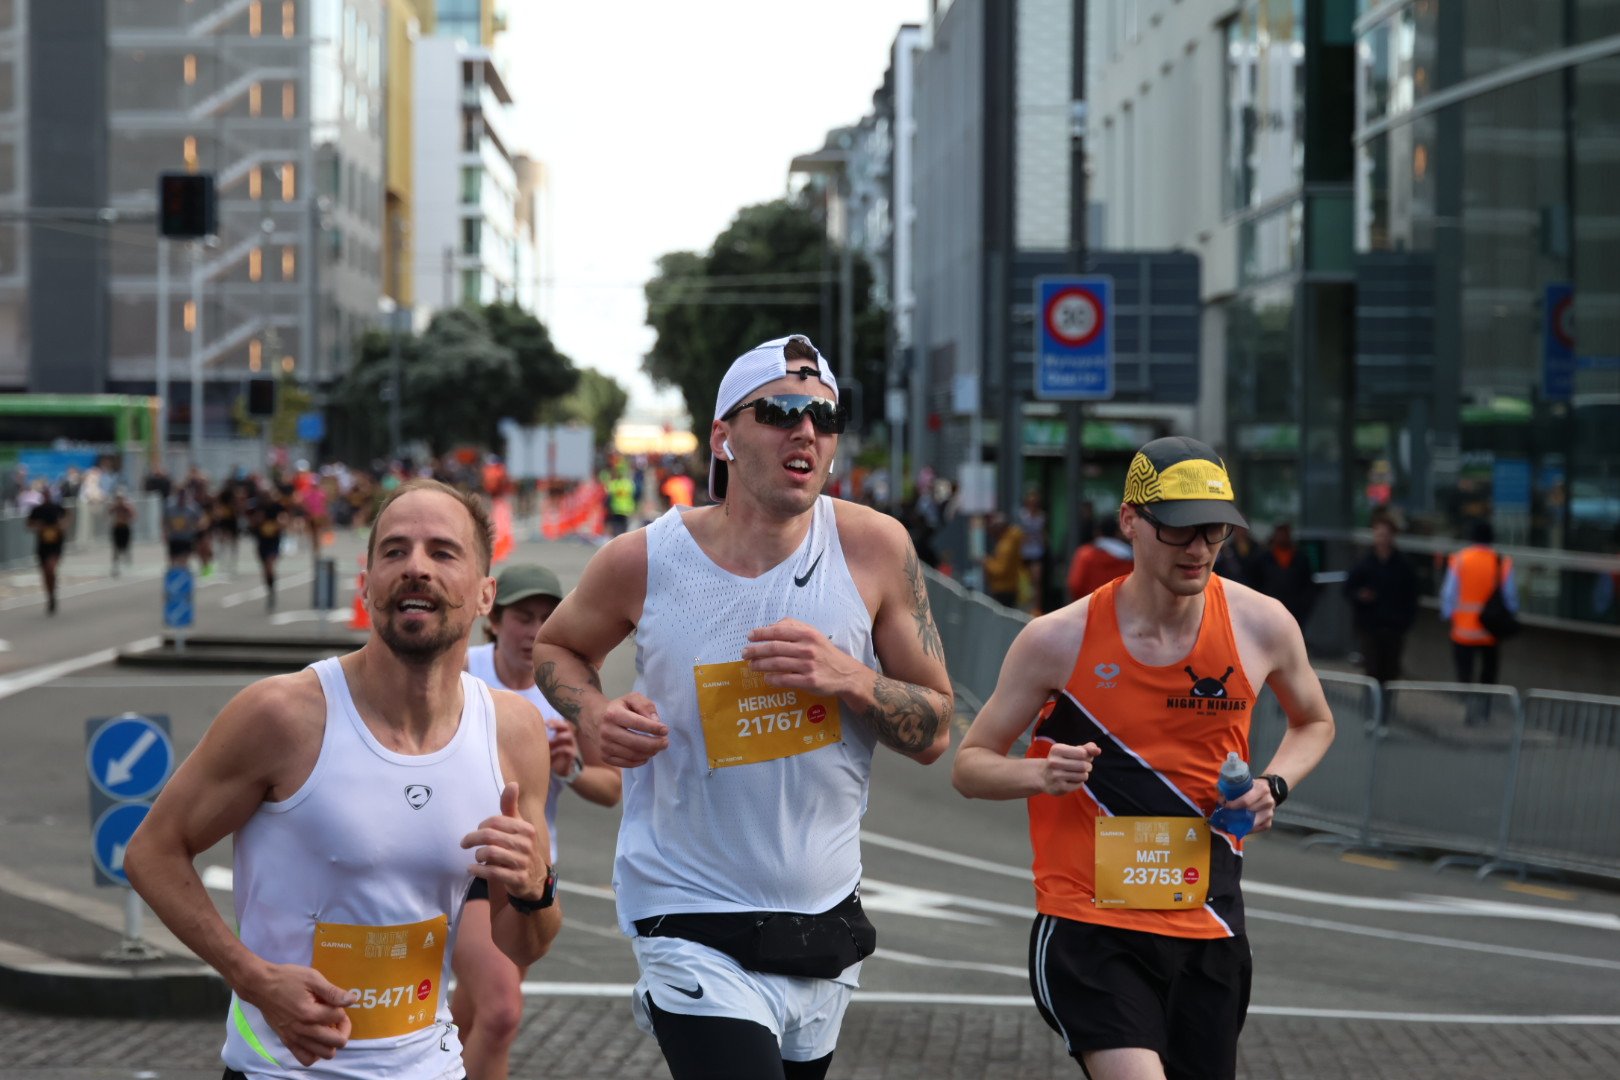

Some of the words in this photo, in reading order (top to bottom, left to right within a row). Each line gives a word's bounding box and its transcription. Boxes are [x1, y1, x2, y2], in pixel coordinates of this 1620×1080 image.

[738, 691, 797, 713] HERKUS
[1166, 697, 1203, 709] NIGHT
[1207, 699, 1247, 711] NINJAS
[736, 709, 803, 738] 21767
[1136, 850, 1171, 863] MATT
[1123, 866, 1183, 885] 23753
[320, 941, 352, 949] GARMIN
[348, 984, 415, 1009] 25471
